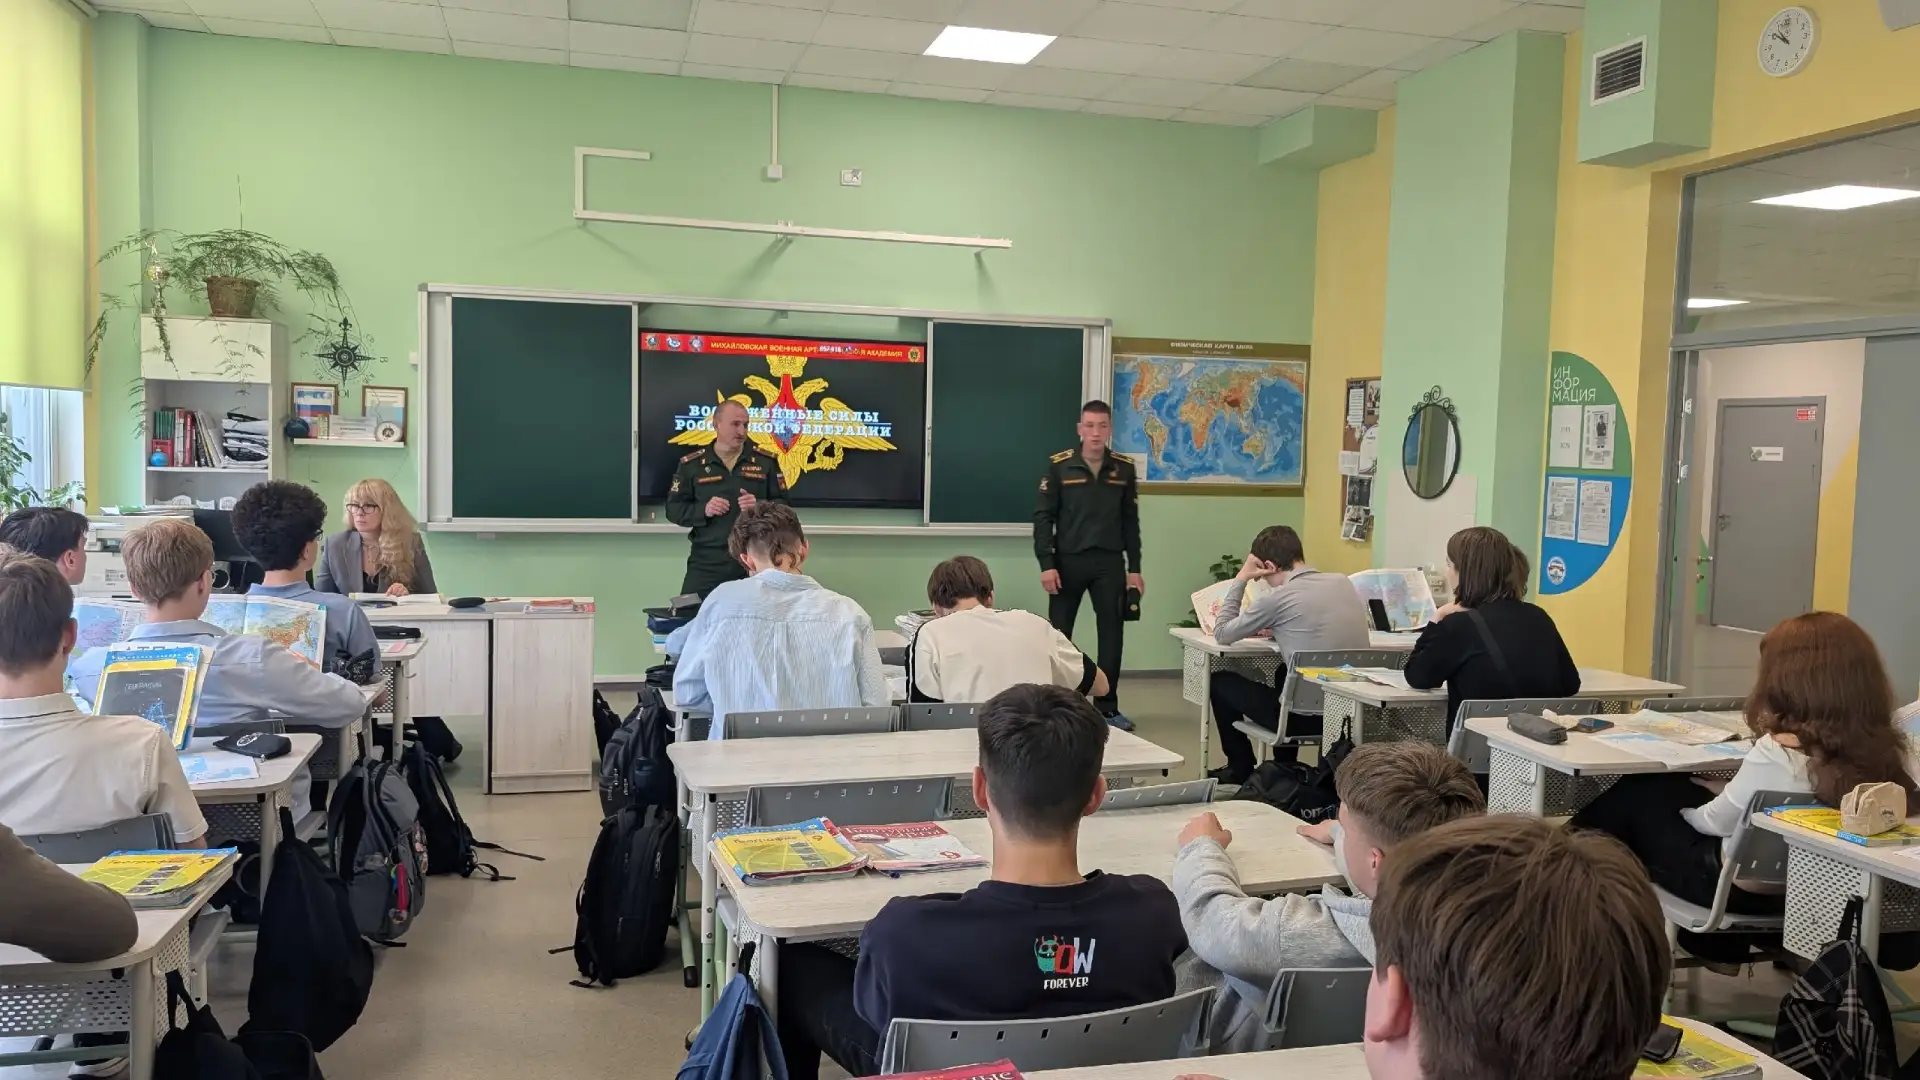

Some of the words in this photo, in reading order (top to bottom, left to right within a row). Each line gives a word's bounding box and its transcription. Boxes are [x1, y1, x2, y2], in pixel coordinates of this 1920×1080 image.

[710, 341, 768, 351] МИХАЙЛОВСКАЯ
[769, 345, 803, 353] ВОЕННАЯ
[867, 350, 903, 358] АКАДЕМИЯ
[1553, 365, 1571, 380] ИН
[1553, 377, 1580, 391] ФОР
[1552, 388, 1597, 403] МАЦИЯ
[688, 404, 824, 421] ВОЖЕННЫЕ
[829, 410, 880, 423] СИЛЫ
[674, 419, 786, 435] РОССКОЙ
[790, 423, 892, 438] ФЕДЕРАЦИИ
[1043, 976, 1089, 990] FOREVER
